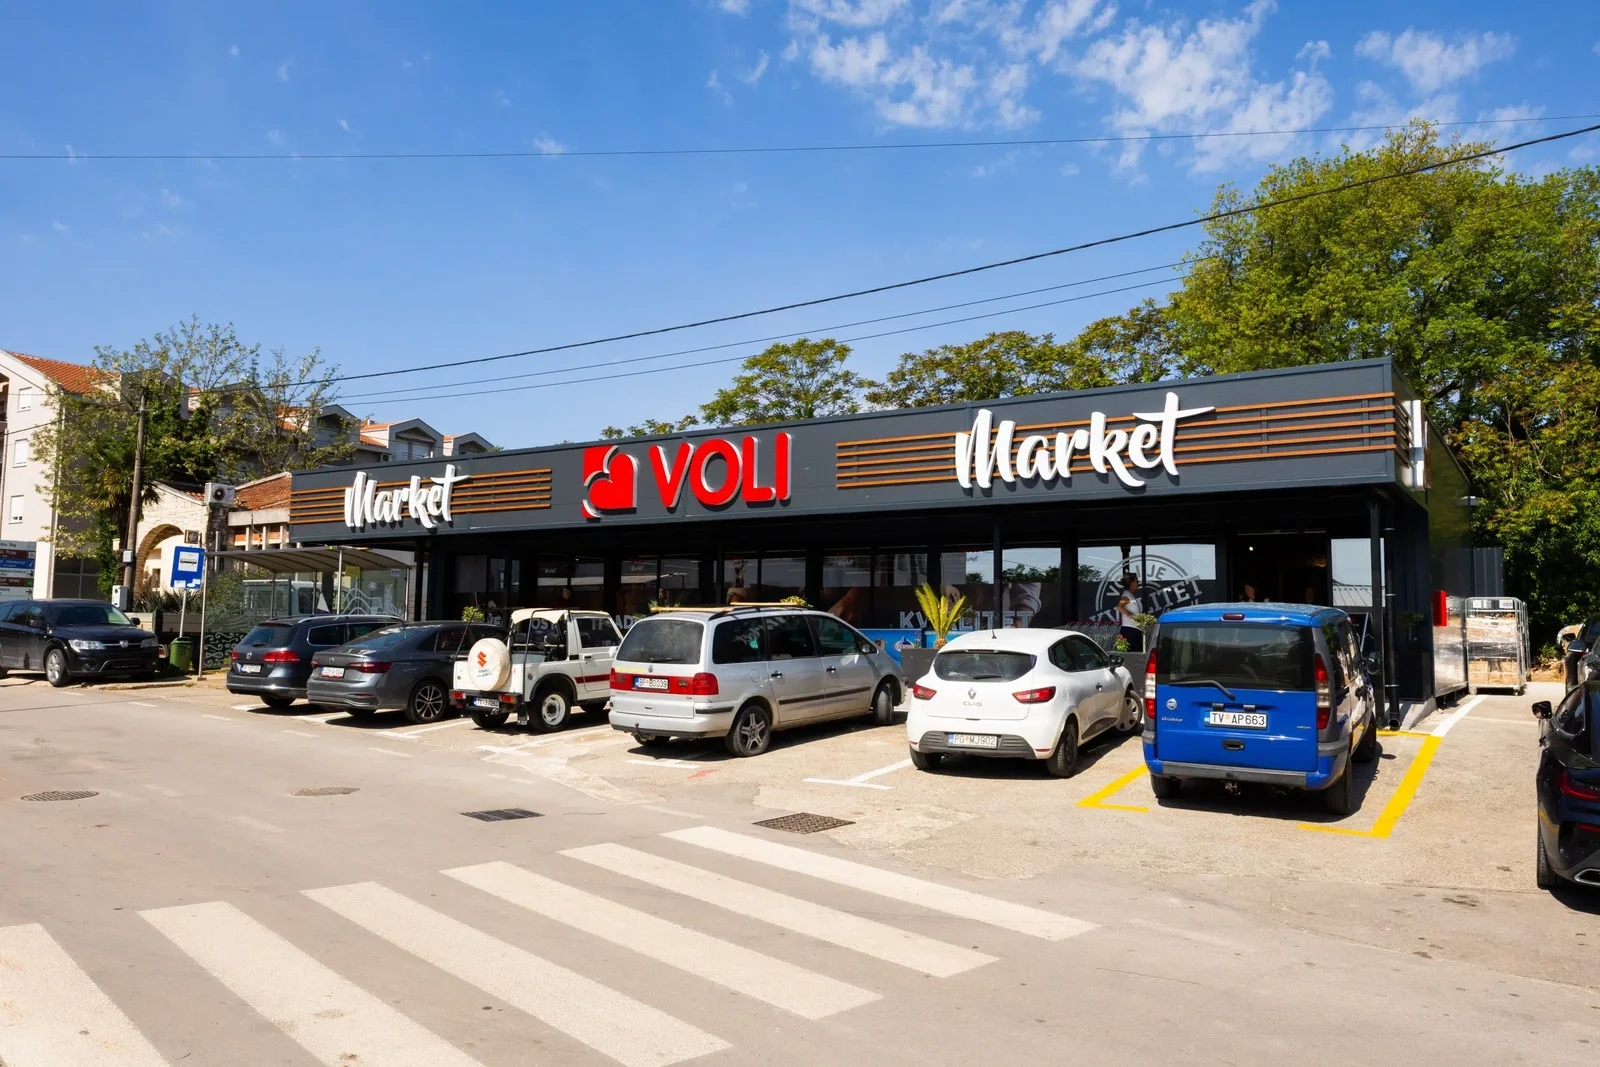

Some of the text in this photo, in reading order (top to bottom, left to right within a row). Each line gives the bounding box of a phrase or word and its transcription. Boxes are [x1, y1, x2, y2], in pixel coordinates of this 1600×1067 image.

[955, 391, 1216, 489] Market
[649, 432, 793, 509] VOLI
[344, 463, 471, 528] Market
[1147, 564, 1167, 580] JE
[1088, 575, 1203, 622] KVLITET
[900, 609, 1035, 630] KVLITET
[1212, 712, 1265, 726] TV AP663
[954, 734, 965, 744] PG
